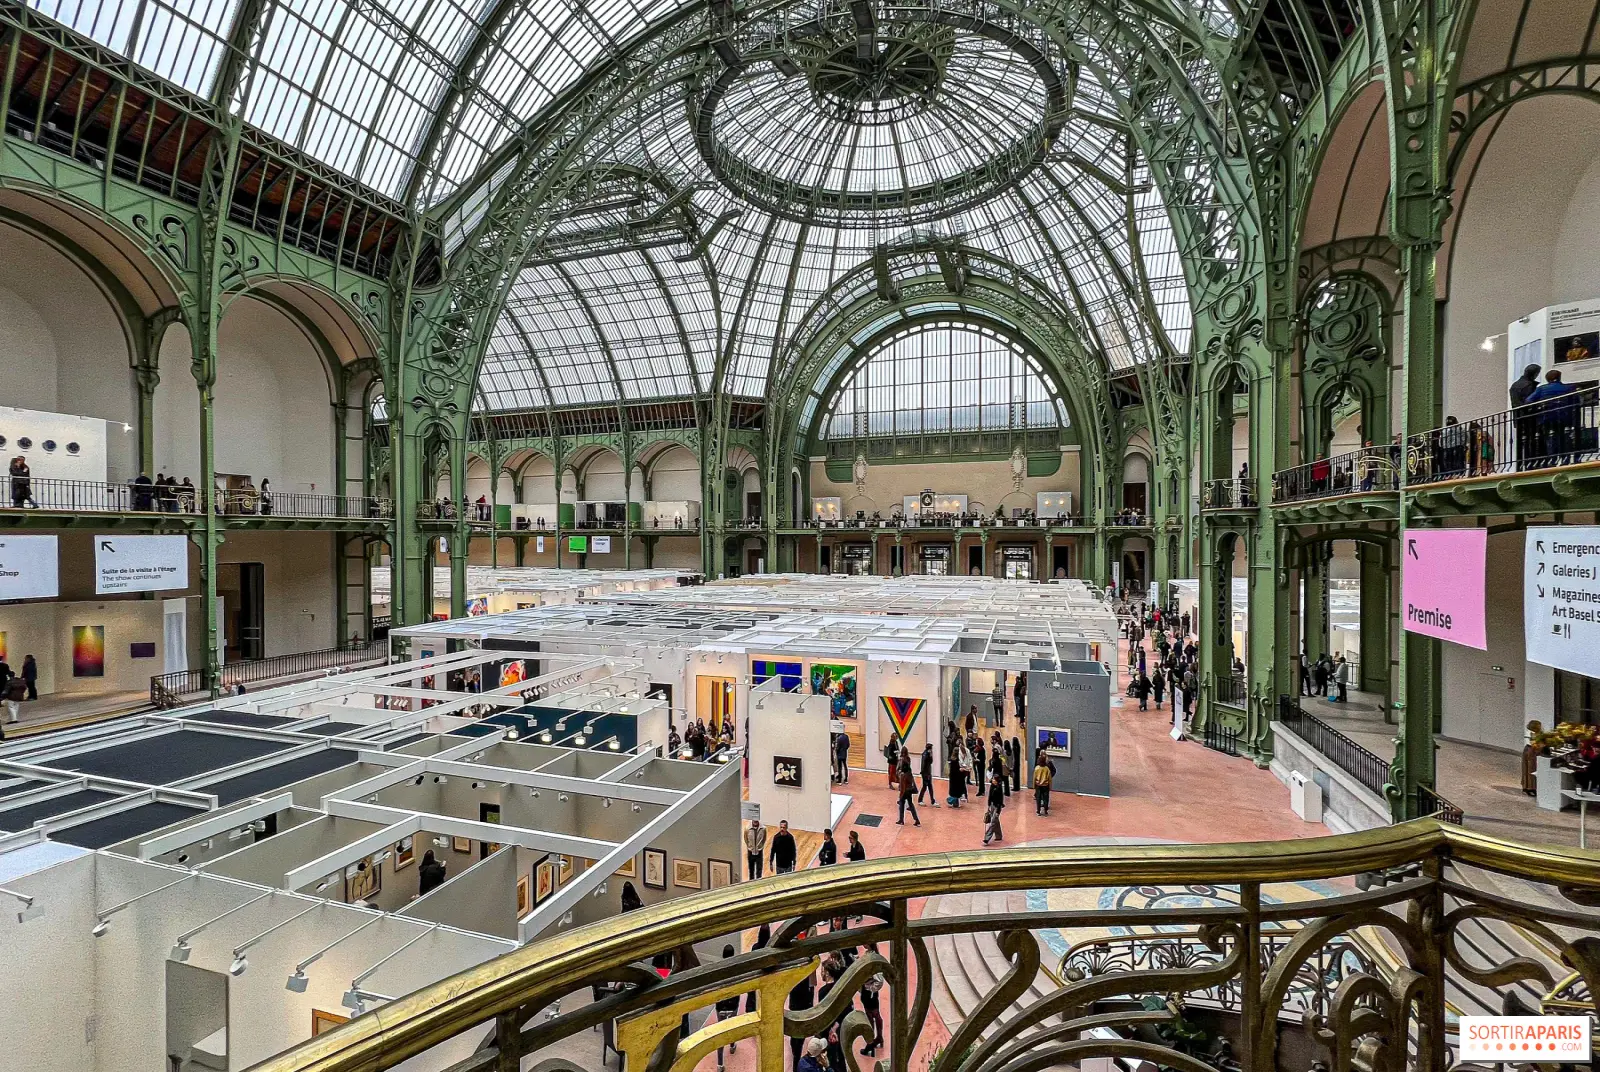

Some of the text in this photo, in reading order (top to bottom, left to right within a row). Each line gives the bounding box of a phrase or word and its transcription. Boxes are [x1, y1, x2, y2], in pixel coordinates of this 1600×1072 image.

[1552, 564, 1590, 578] Galeries
[1408, 603, 1452, 630] Premise
[1552, 605, 1567, 618] Art
[1568, 607, 1594, 622] Basel
